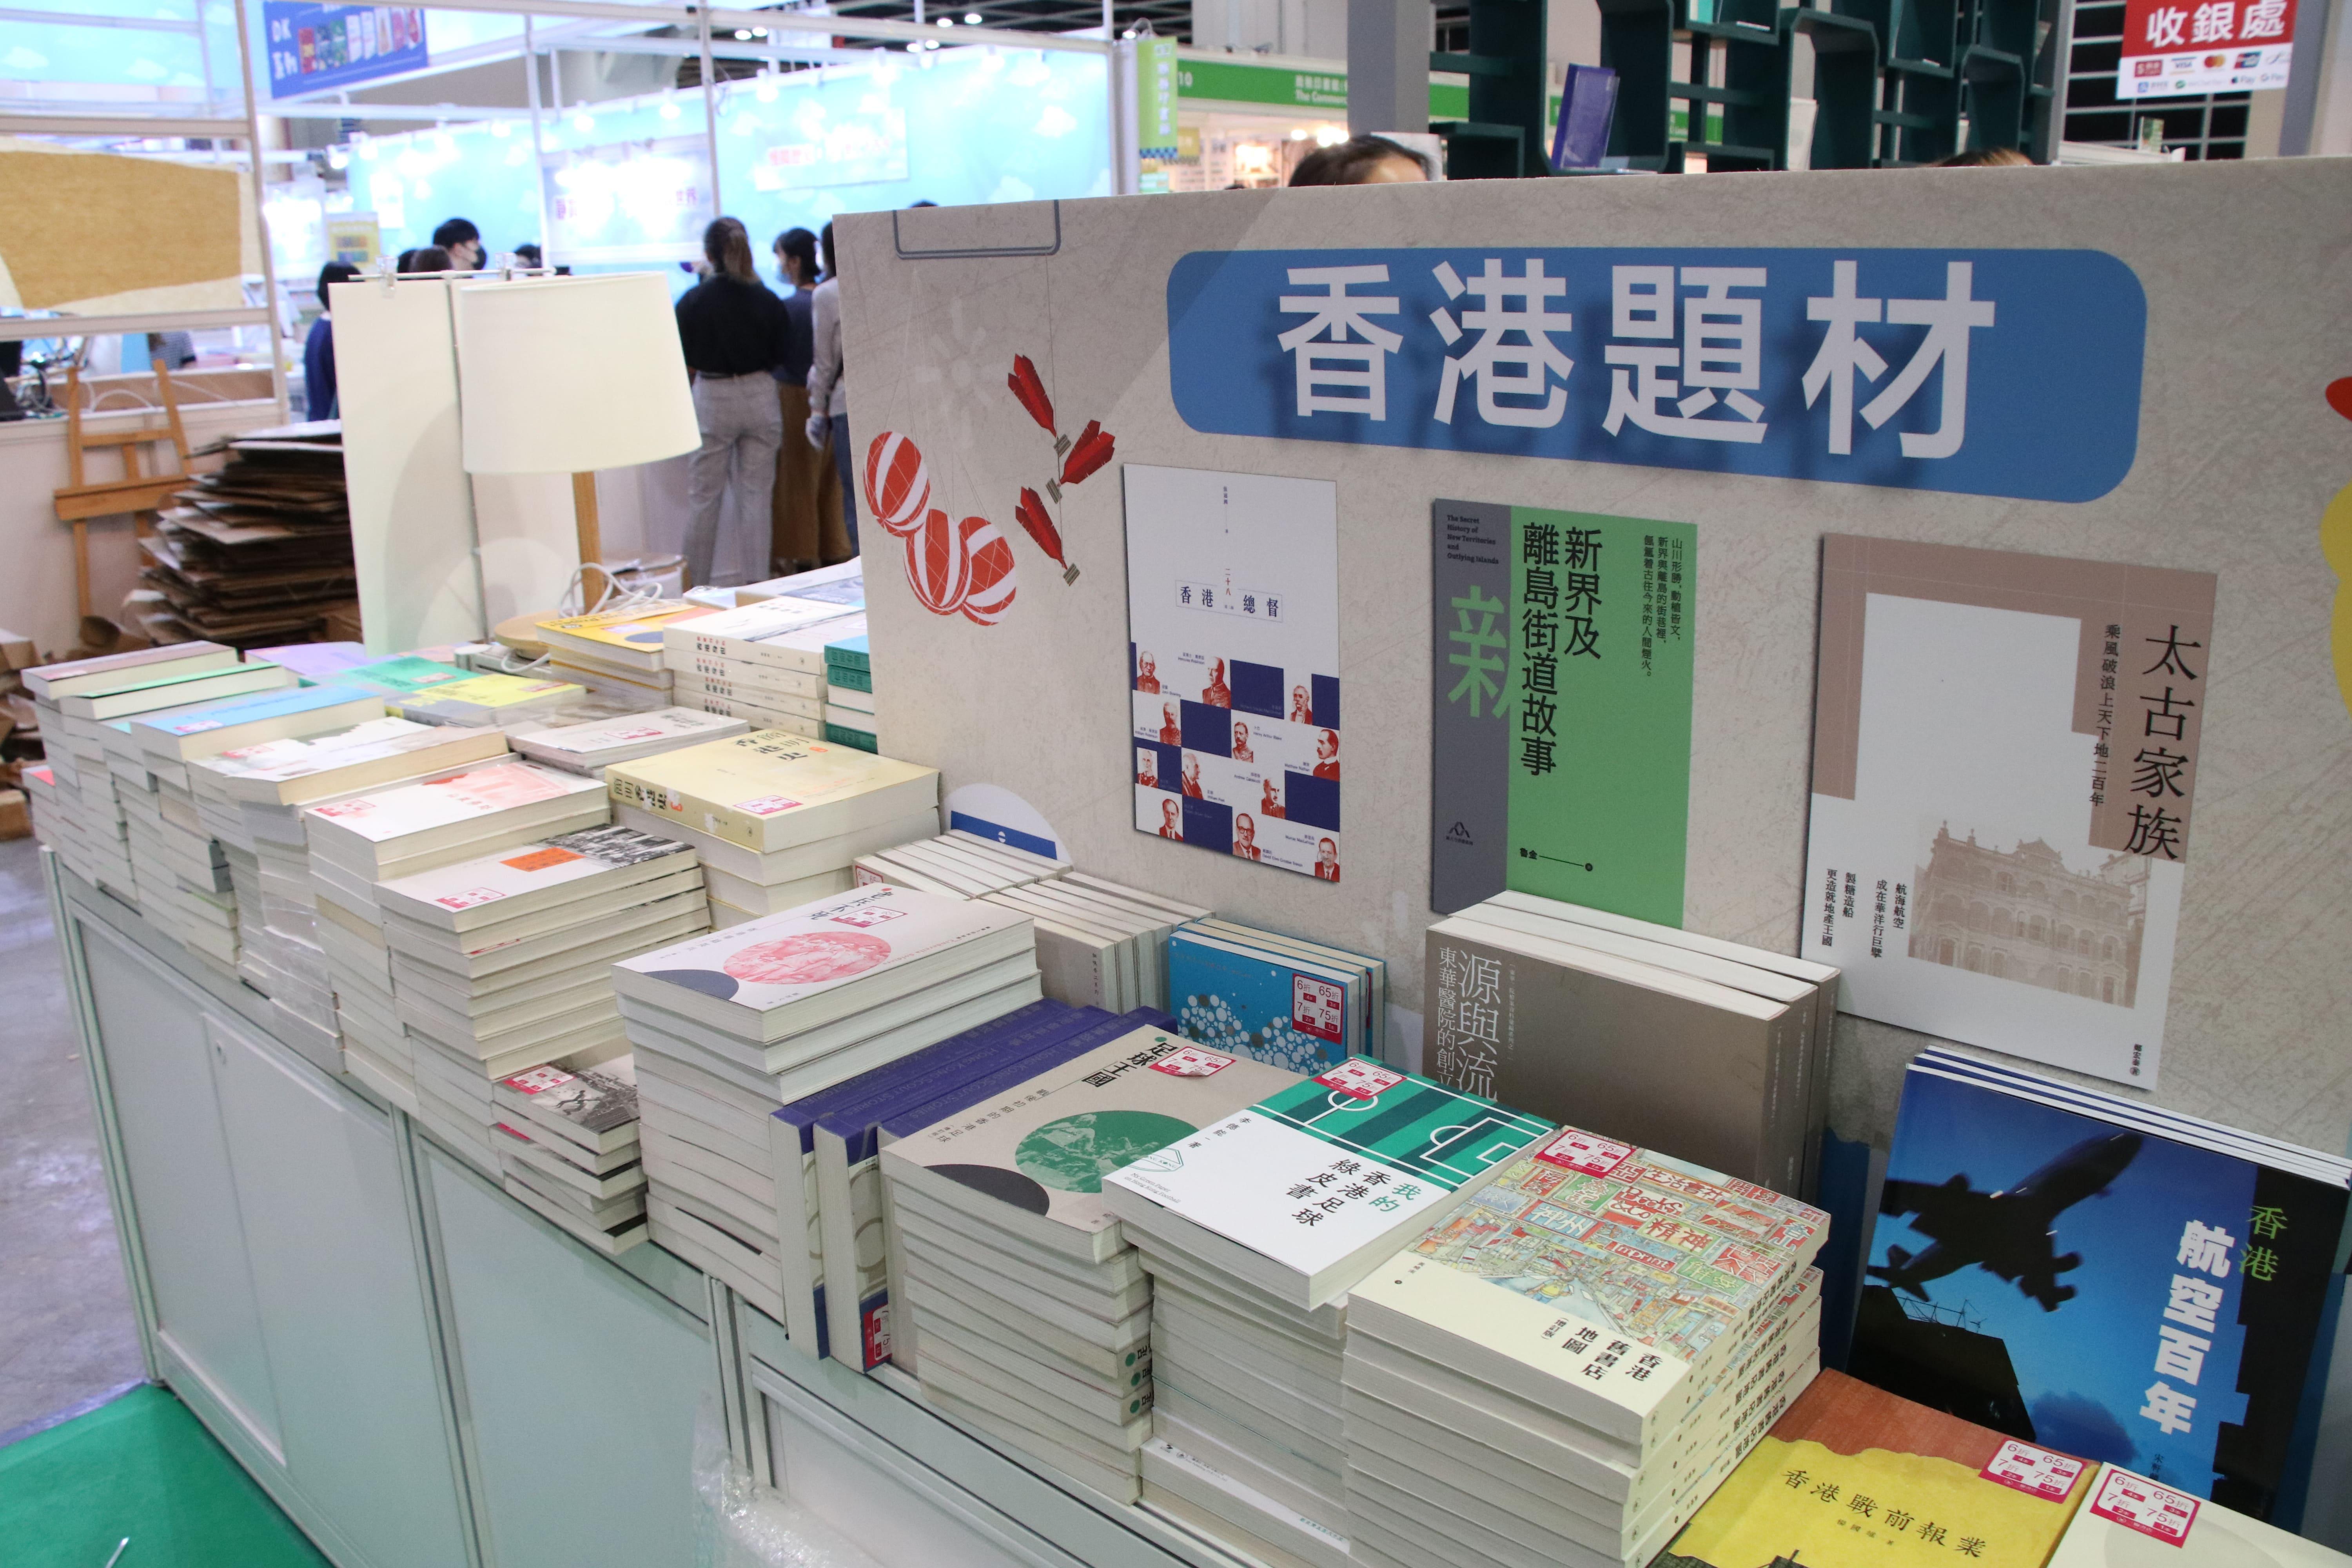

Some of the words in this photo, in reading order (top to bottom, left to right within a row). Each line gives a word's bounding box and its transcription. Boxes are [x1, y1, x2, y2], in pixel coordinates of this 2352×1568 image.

[2146, 0, 2287, 48] 收銀處
[1277, 259, 1996, 459] 香港題材
[1447, 524, 1470, 534] History
[1460, 516, 1480, 524] Secret
[1462, 535, 1496, 545] Territories
[1447, 553, 1475, 563] Outlying
[1475, 556, 1499, 564] Islands
[1180, 586, 1279, 618] 香港總督
[1564, 526, 1602, 659] 新界及
[1521, 522, 1559, 776] 離島街道故事
[2089, 624, 2121, 807] 乘風破浪上天下地二百年
[2124, 624, 2201, 860] 太古家族
[1519, 847, 1538, 860] 魯金
[809, 891, 893, 920] 老兵不死
[1822, 868, 1838, 947] 更造就地產王國
[1842, 872, 1856, 918] 製糖造船
[1893, 883, 1907, 929] 航海航空
[1871, 879, 1888, 958] 成在華洋行巨擘
[1297, 980, 1310, 993] 6折
[1319, 986, 1339, 1001] 65折
[1297, 1002, 1310, 1015] 7折
[1319, 1009, 1338, 1024] 75折
[1456, 950, 1502, 1102] 源與流
[1082, 1042, 1178, 1087] 足球王國
[1349, 1062, 1367, 1071] 6折
[1372, 1071, 1397, 1082] 65折
[1332, 1071, 1349, 1079] 7折
[1356, 1080, 1379, 1091] 75折
[1213, 1117, 1251, 1137] 李德能
[1555, 1144, 1573, 1154] 7折
[1584, 1153, 1613, 1167] 75折
[1568, 1134, 1587, 1143] 6折
[1597, 1142, 1626, 1155] 65折
[1131, 1177, 1145, 1189] Hong
[1145, 1185, 1159, 1195] Kong
[1158, 1190, 1182, 1204] Football
[1138, 1175, 1154, 1186] Green
[1155, 1182, 1171, 1193] Paper
[1286, 1158, 1363, 1200] 綠皮書
[1291, 1171, 1392, 1227] 香港足球
[1368, 1182, 1422, 1212] 我的
[1623, 1186, 1683, 1216] Books
[1525, 1205, 1595, 1238] 神州
[1646, 1218, 1713, 1252] 精神
[1611, 1243, 1671, 1269] Imprint
[2238, 1205, 2288, 1281] 香港
[1561, 1327, 1599, 1354] 地圖
[2139, 1219, 2235, 1435] 航空百年
[1580, 1339, 1632, 1380] 舊書店
[1625, 1353, 1663, 1381] 香港
[1997, 1458, 2020, 1472] 7折
[2033, 1470, 2067, 1487] 75折
[2007, 1443, 2031, 1457] 6折
[2043, 1455, 2076, 1471] 65折
[2114, 1476, 2140, 1492] 6折
[2153, 1490, 2190, 1511] 65折
[1782, 1470, 1986, 1557] 香港戰前報業
[2107, 1492, 2131, 1509] 7折
[2146, 1507, 2183, 1529] 75折
